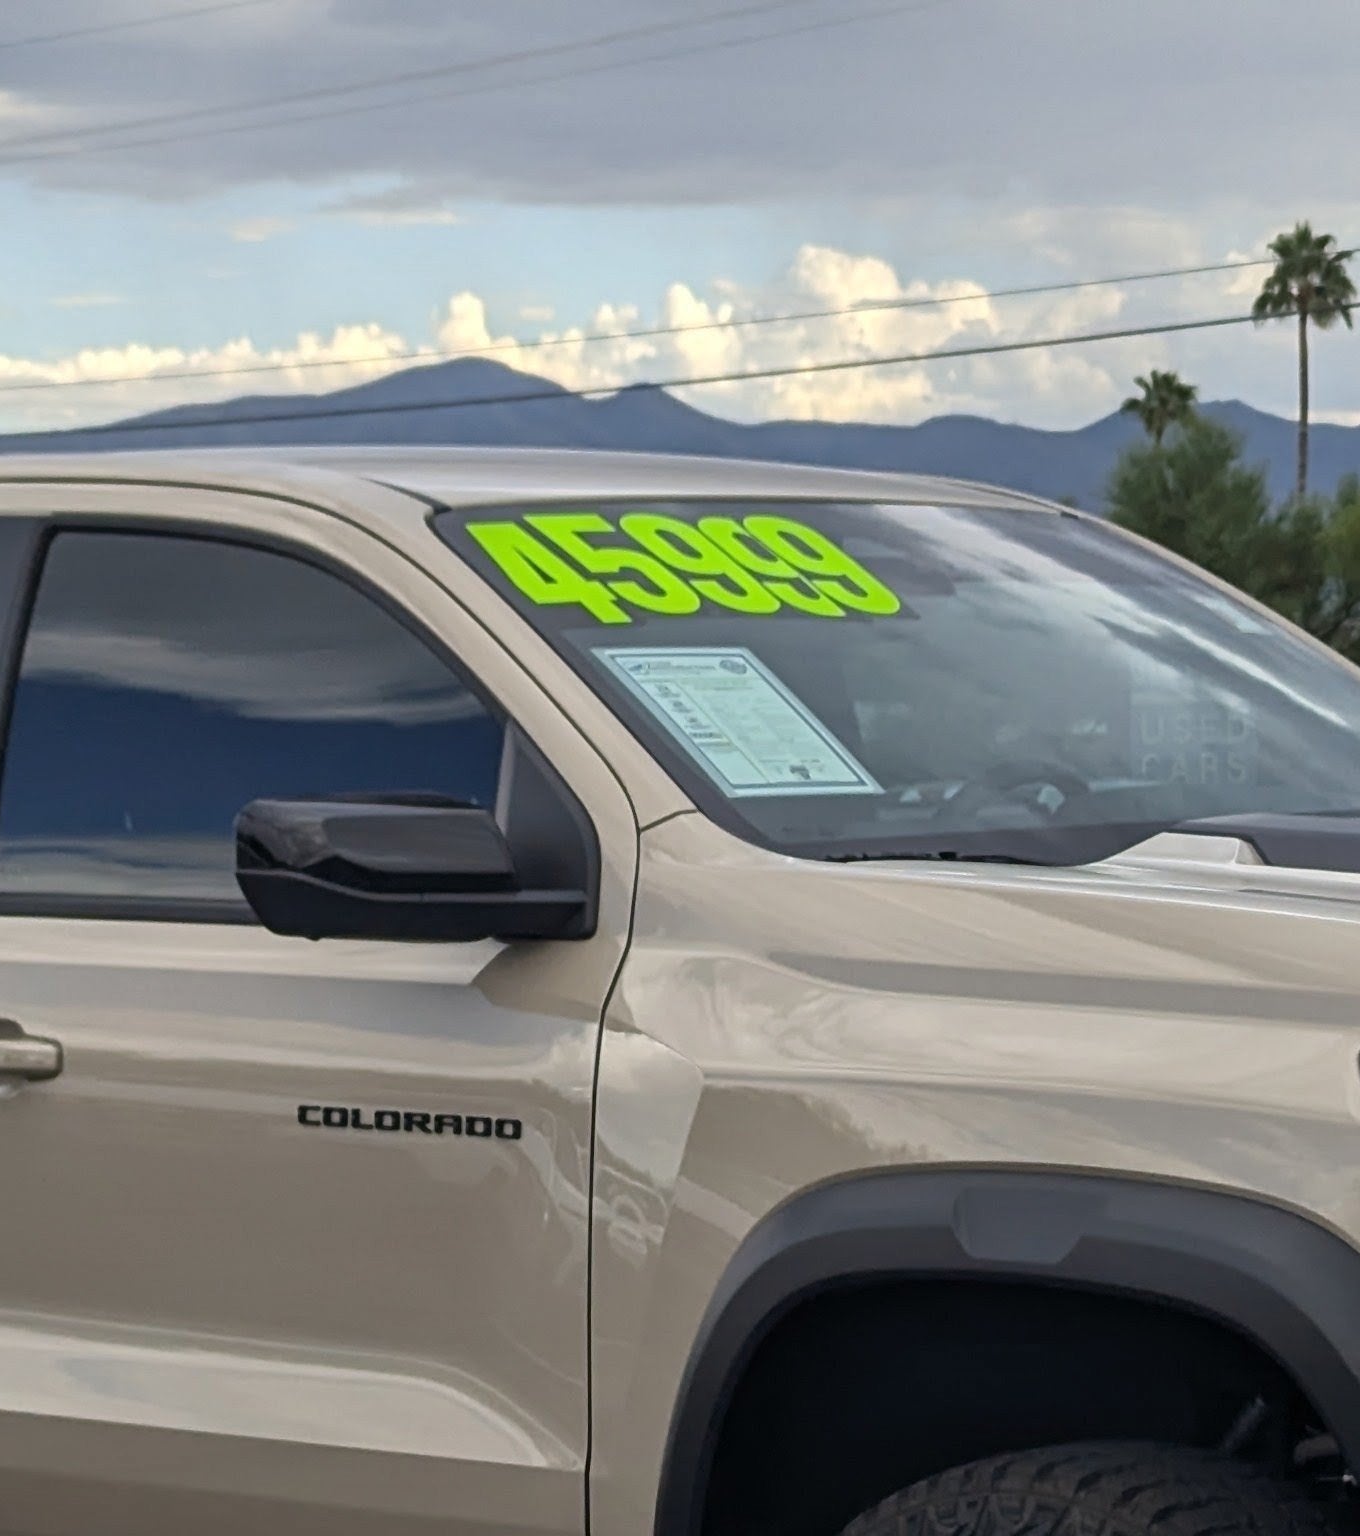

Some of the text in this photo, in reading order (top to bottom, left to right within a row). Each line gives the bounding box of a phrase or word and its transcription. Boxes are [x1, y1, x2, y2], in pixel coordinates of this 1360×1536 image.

[465, 512, 901, 624] 45999
[1140, 712, 1251, 745] USED
[297, 1105, 523, 1140] COLORADO
